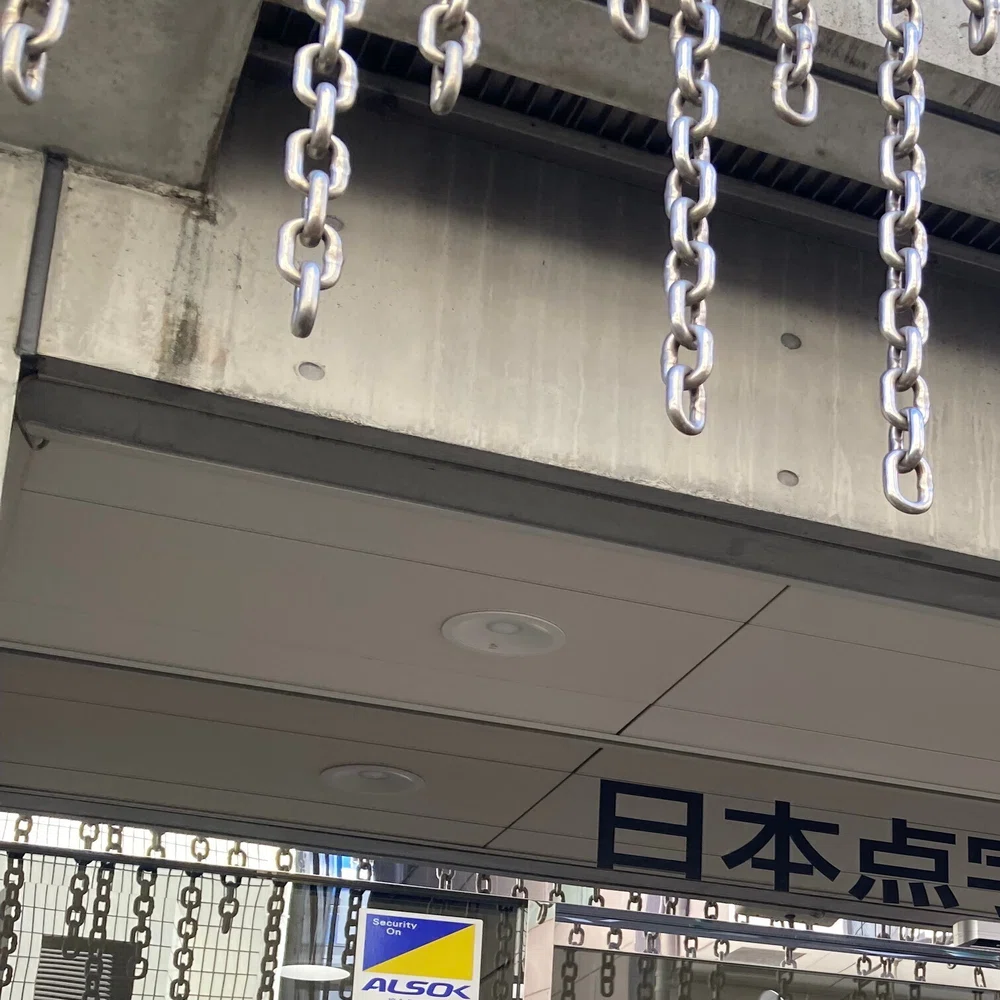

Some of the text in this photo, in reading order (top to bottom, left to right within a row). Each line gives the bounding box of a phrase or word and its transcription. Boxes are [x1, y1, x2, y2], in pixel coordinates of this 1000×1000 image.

[372, 917, 418, 930] Security
[386, 928, 402, 936] On
[362, 977, 471, 1000] ALSOK
